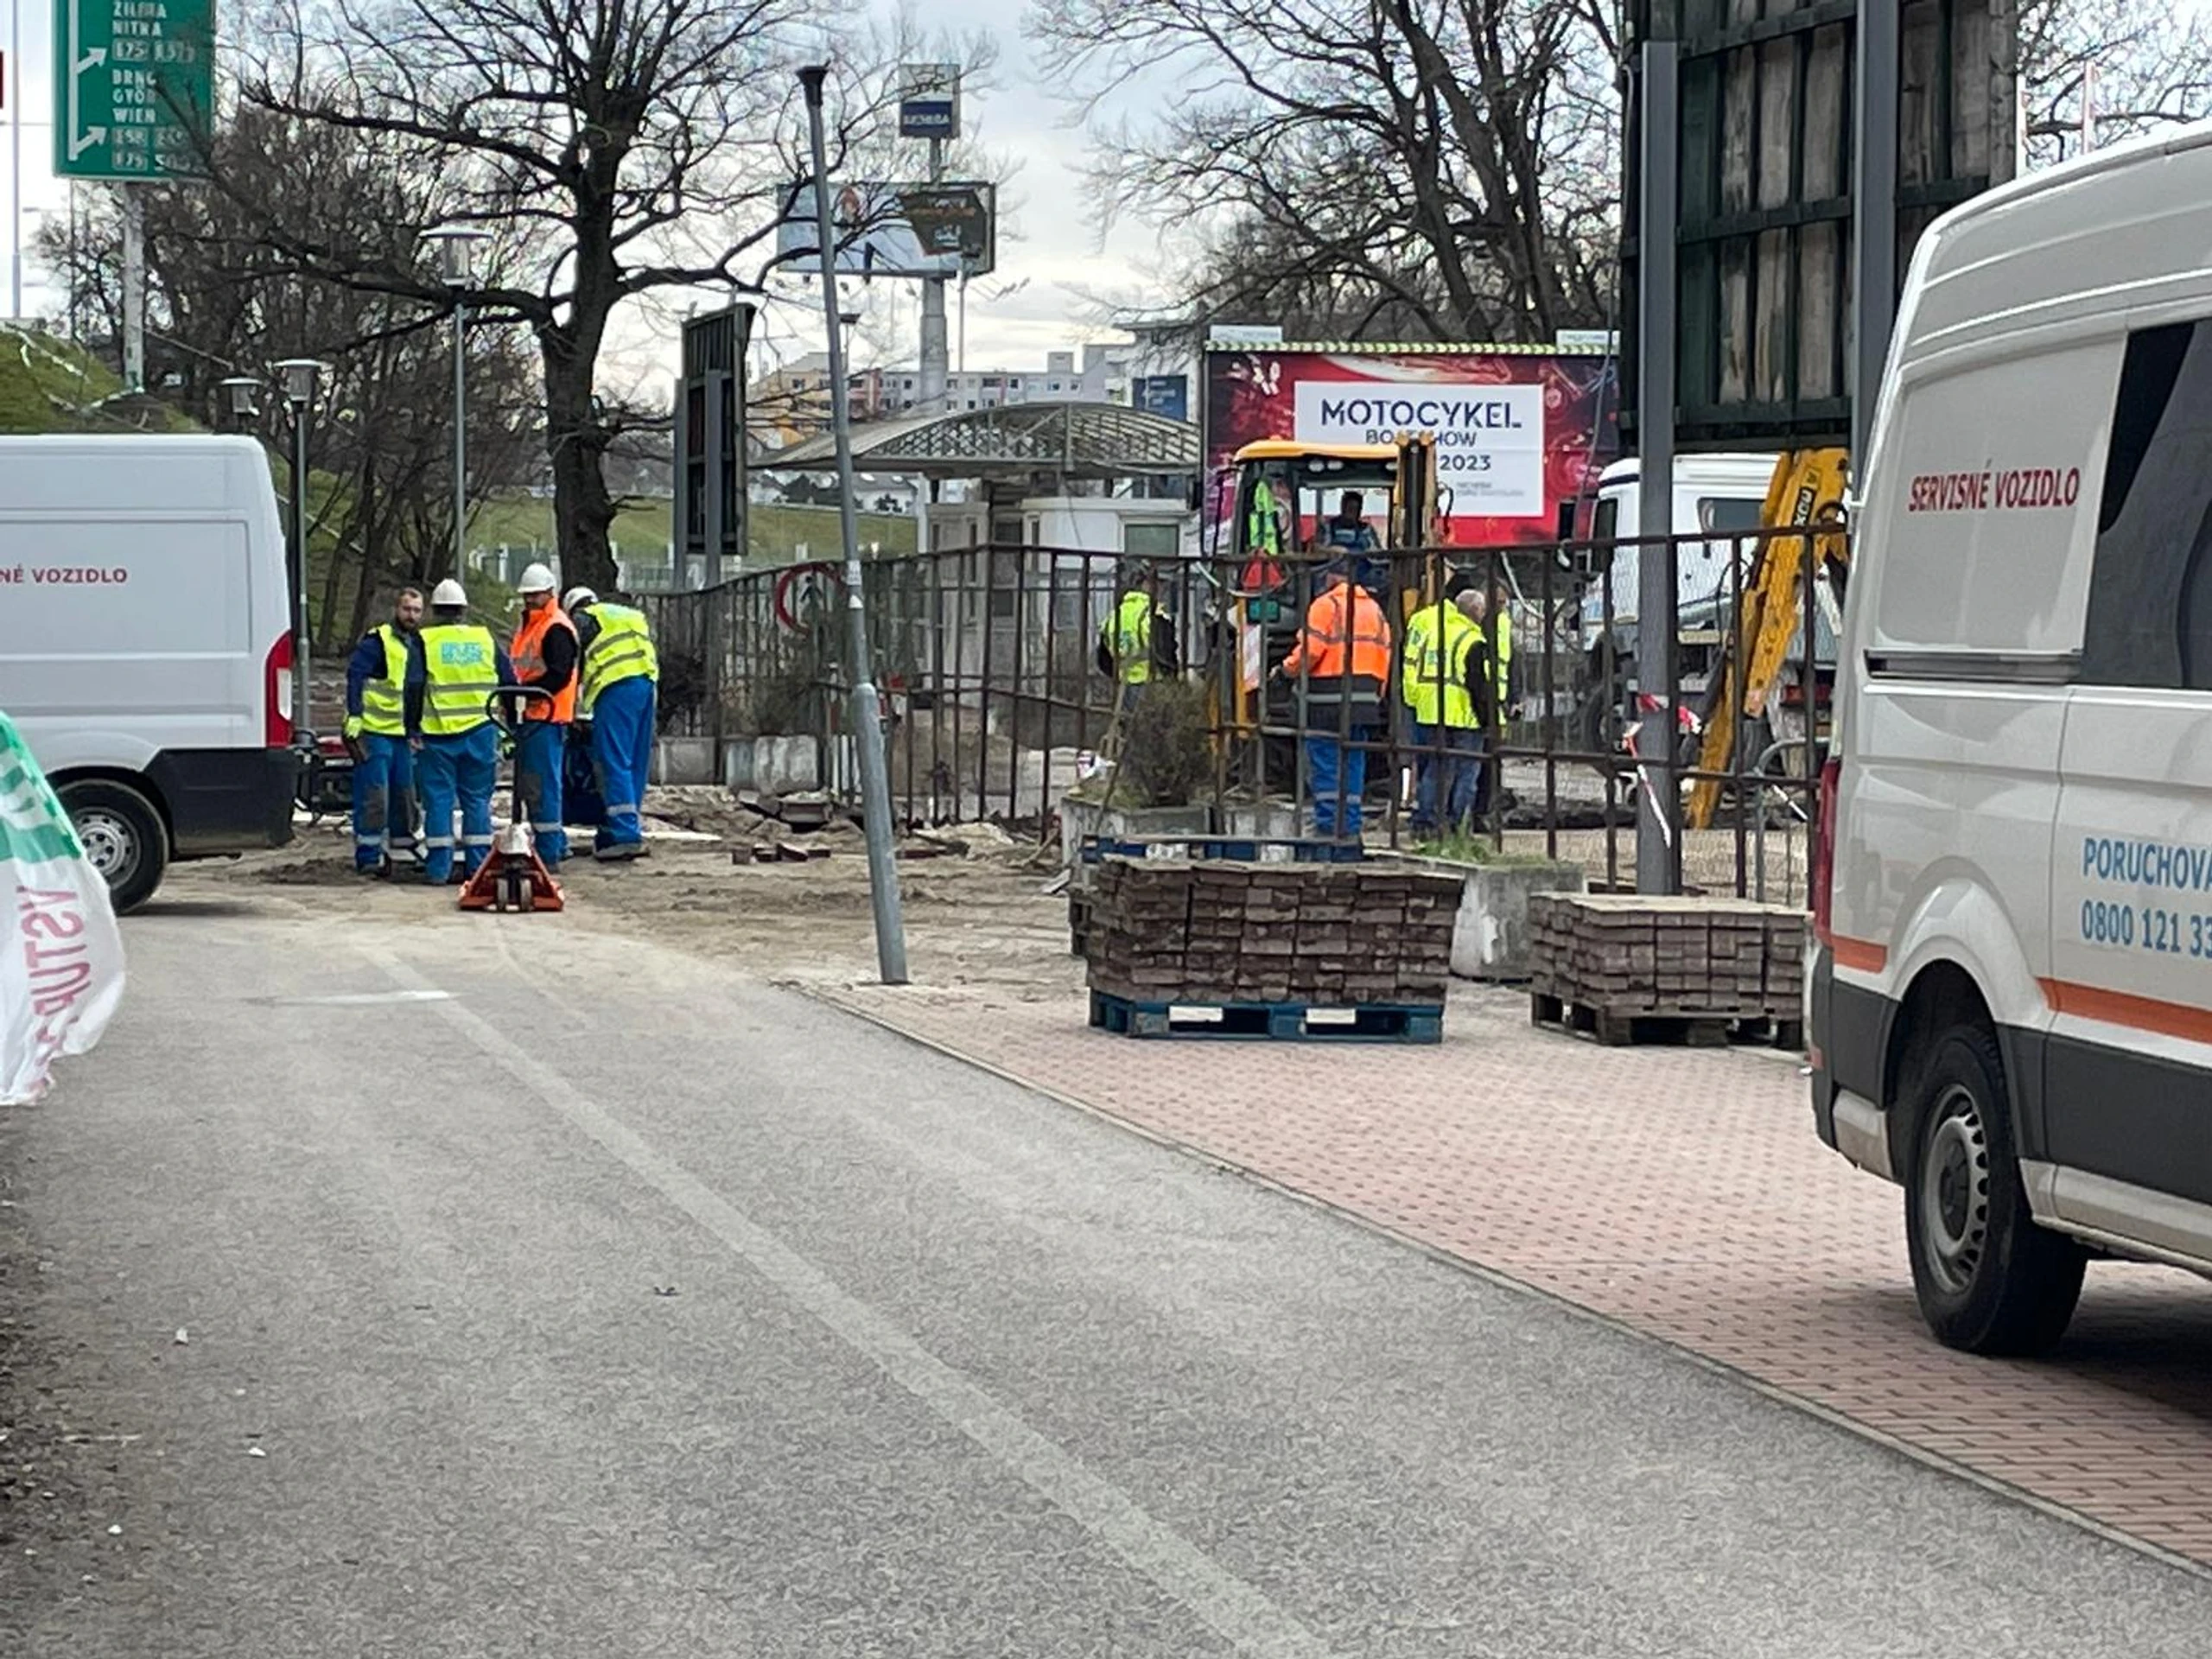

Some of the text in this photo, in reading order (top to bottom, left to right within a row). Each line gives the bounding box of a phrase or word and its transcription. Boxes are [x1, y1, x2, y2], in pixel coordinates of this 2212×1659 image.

[112, 20, 162, 35] NITRA
[112, 107, 156, 123] WIEN
[1321, 398, 1522, 429] MOTOCYKEL
[1439, 454, 1491, 471] 2023
[1908, 458, 2081, 512] SERVISNÉ VOZIDLO
[31, 567, 128, 583] VOZIDLO
[2082, 899, 2134, 946] 0800
[2142, 908, 2182, 953] 121
